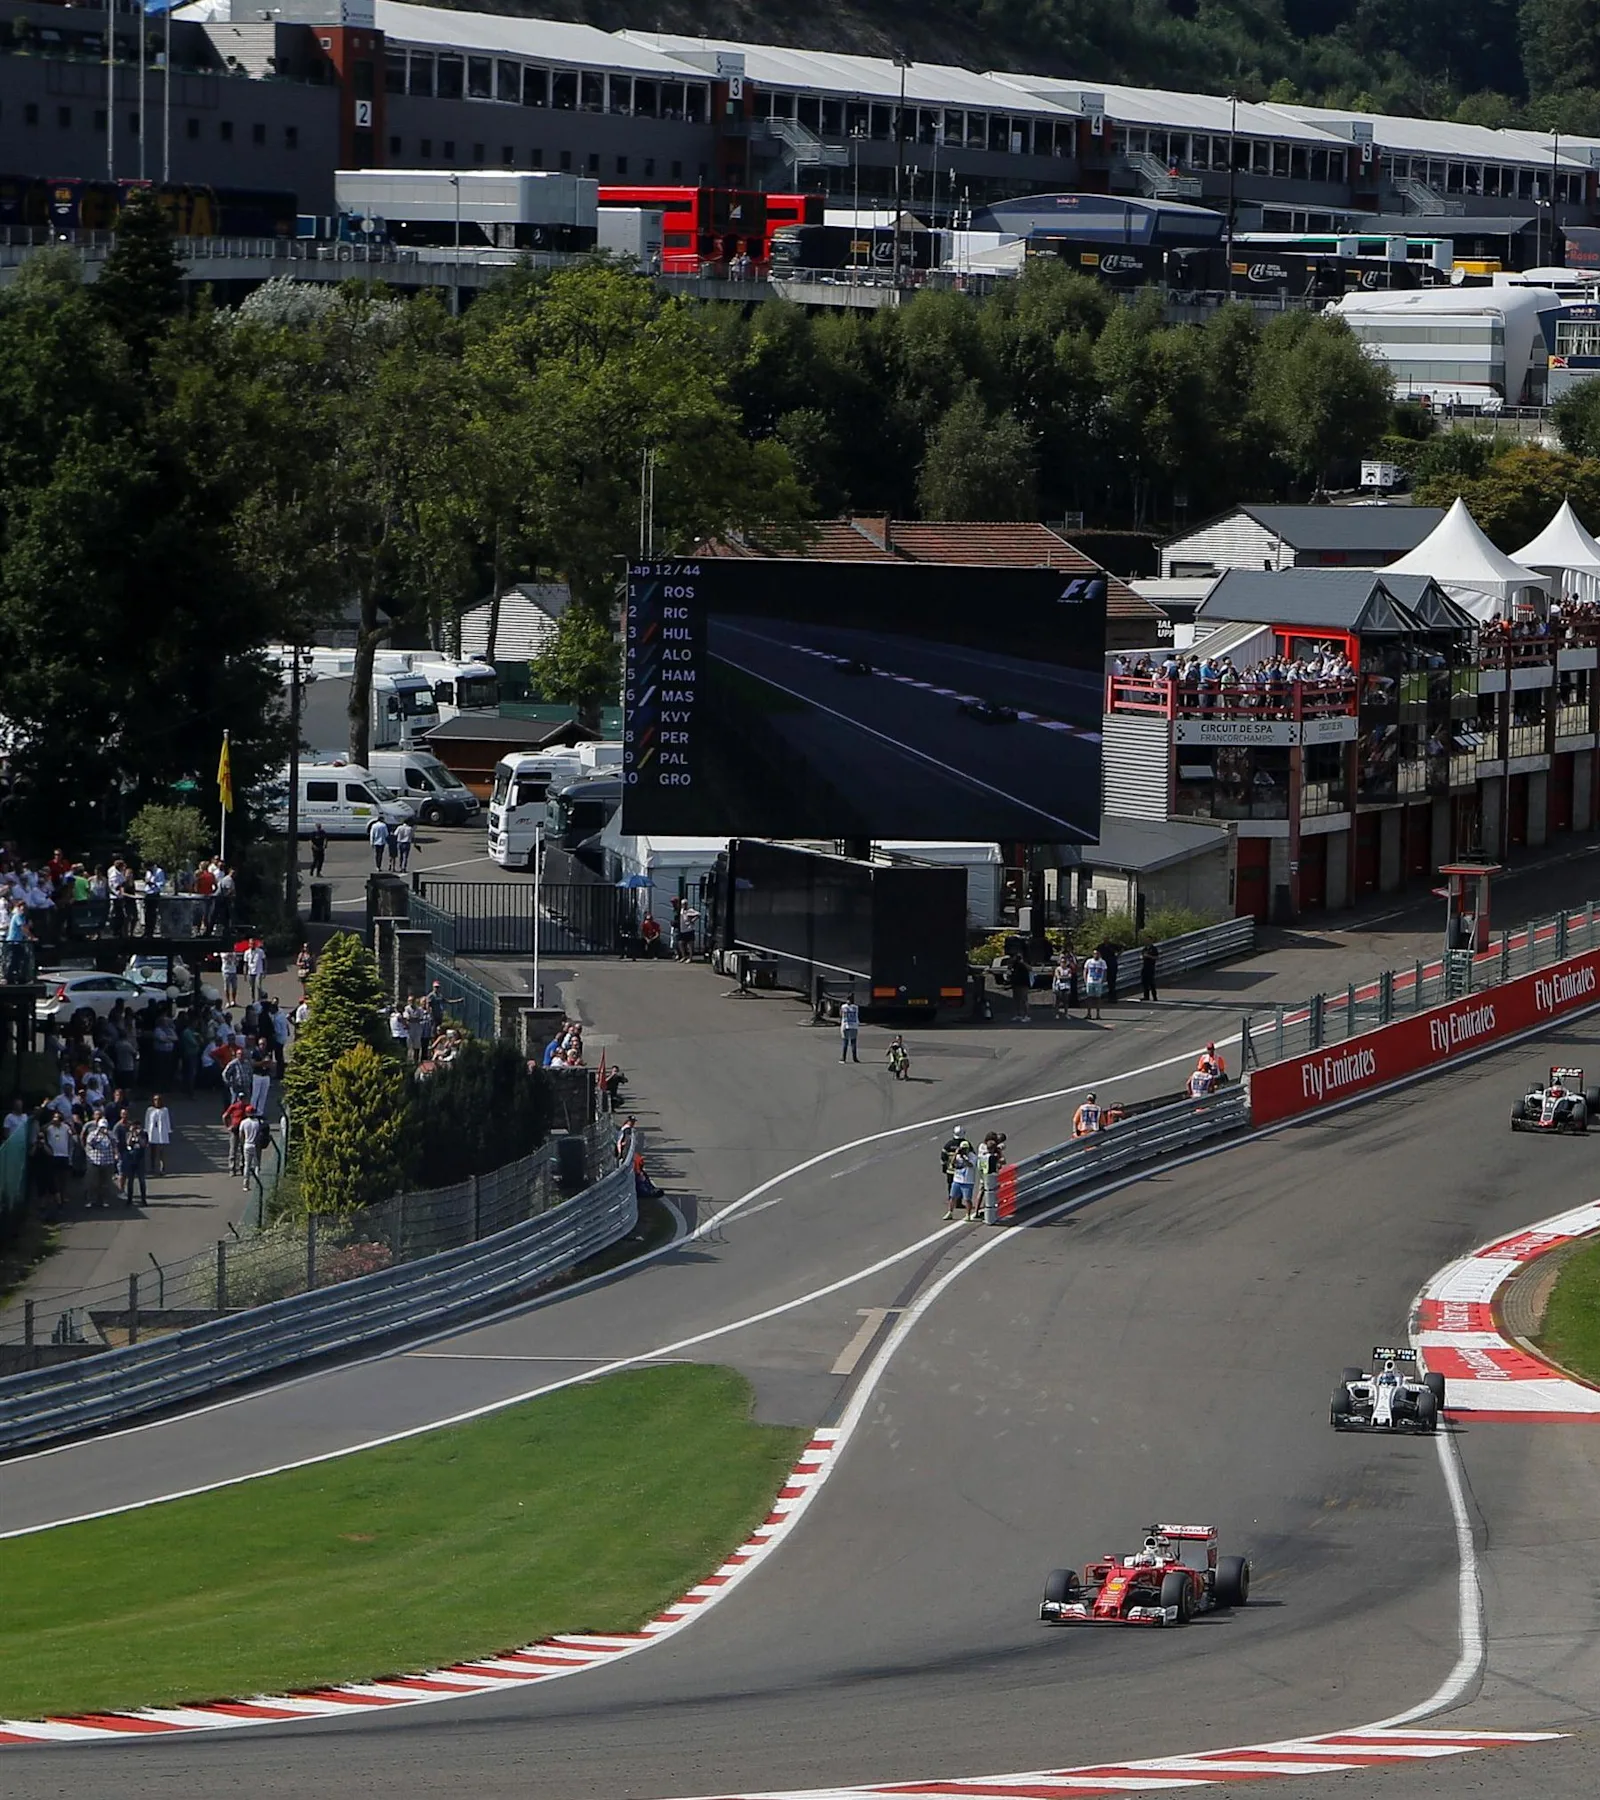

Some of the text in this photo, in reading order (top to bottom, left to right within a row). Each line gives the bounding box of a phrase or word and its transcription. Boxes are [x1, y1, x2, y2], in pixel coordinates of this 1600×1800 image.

[732, 77, 740, 97] 3
[360, 103, 368, 124] 2
[1094, 115, 1101, 133] 4
[1365, 143, 1371, 160] 5
[655, 564, 701, 576] 12/44
[629, 585, 695, 598] 1 ROS
[628, 605, 688, 619] 2 RIC
[628, 626, 692, 640] 3 HUL
[627, 647, 692, 661] 4 ALO
[627, 668, 696, 681] 5 HAM
[626, 688, 694, 702] 6 MAS
[626, 710, 691, 723] 7 KVY
[1201, 724, 1273, 734] CIRCUIT DE SPA
[625, 730, 689, 744] 8 PER
[625, 751, 688, 765] 9 PAL
[659, 773, 691, 785] GRO
[1535, 965, 1596, 1012] Fly Emirates
[1430, 1002, 1496, 1053] Fly Emirates
[1302, 1047, 1376, 1099] Fly Emirates
